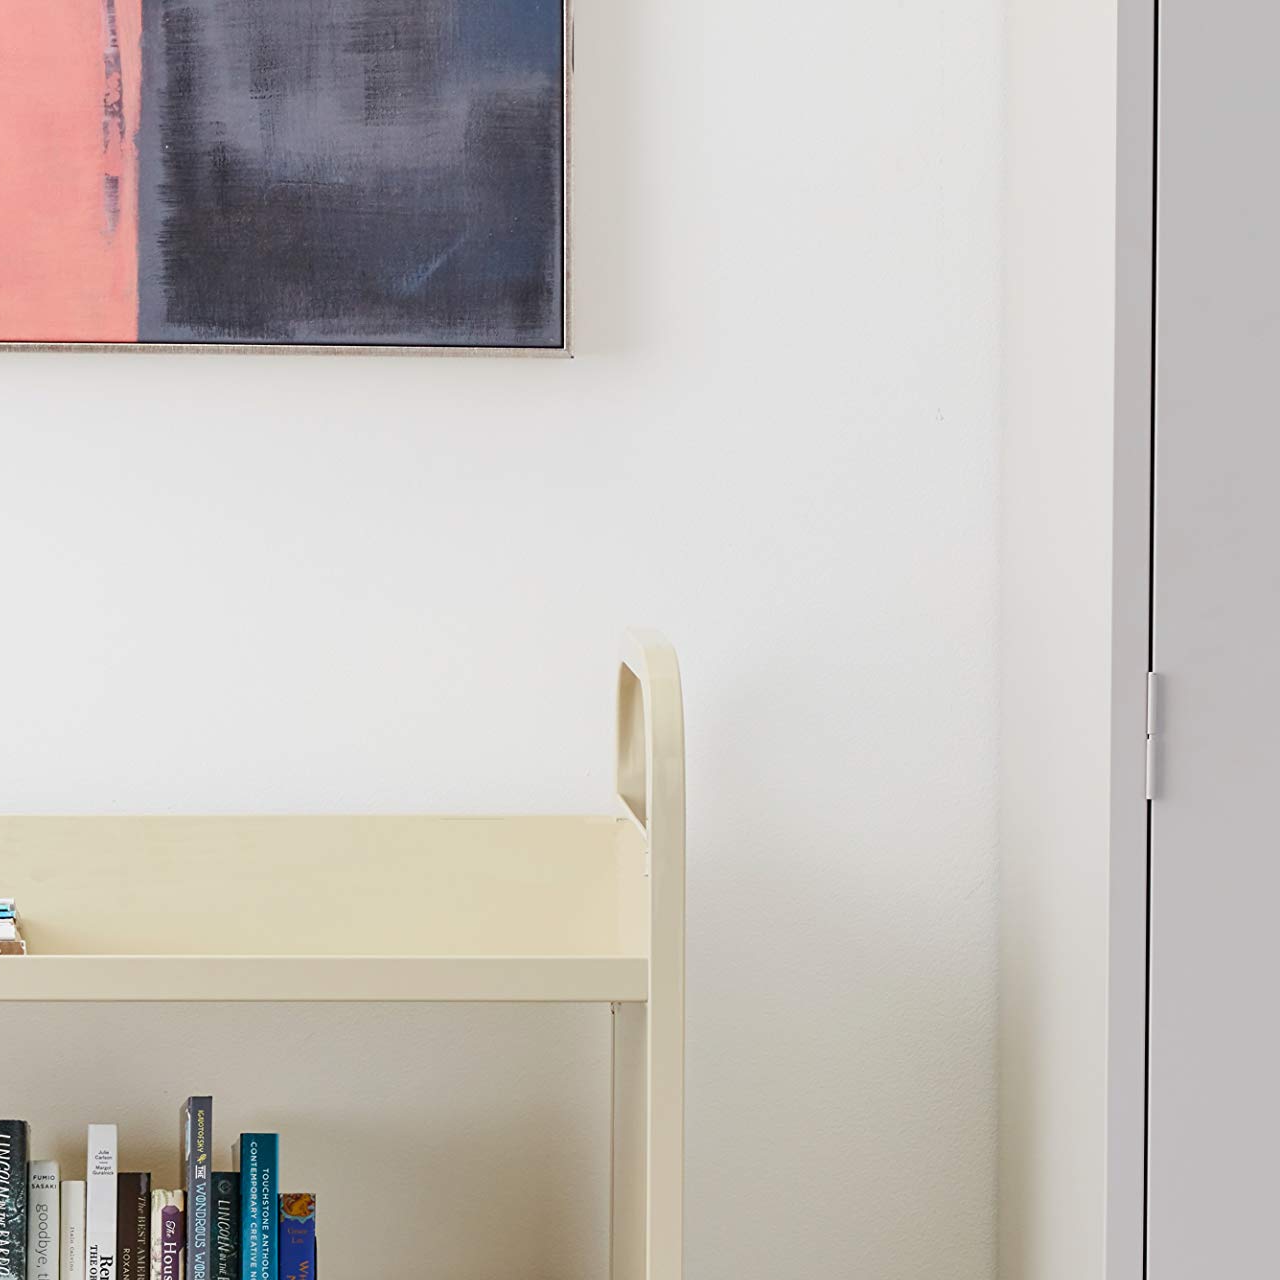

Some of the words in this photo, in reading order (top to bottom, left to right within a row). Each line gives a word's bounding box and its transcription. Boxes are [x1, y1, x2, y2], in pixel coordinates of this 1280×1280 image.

[196, 1165, 206, 1179] THE
[250, 1141, 258, 1219] CONTEMPORARY
[137, 1196, 147, 1214] The
[195, 1182, 207, 1249] WONDROUS
[261, 1168, 270, 1230] TOUCHSTONE
[35, 1204, 51, 1268] goodbye,
[136, 1216, 146, 1245] BEST
[165, 1220, 176, 1238] The
[217, 1200, 231, 1250] LINCOLN
[250, 1222, 258, 1267] CREATIVE
[89, 1244, 98, 1265] THE
